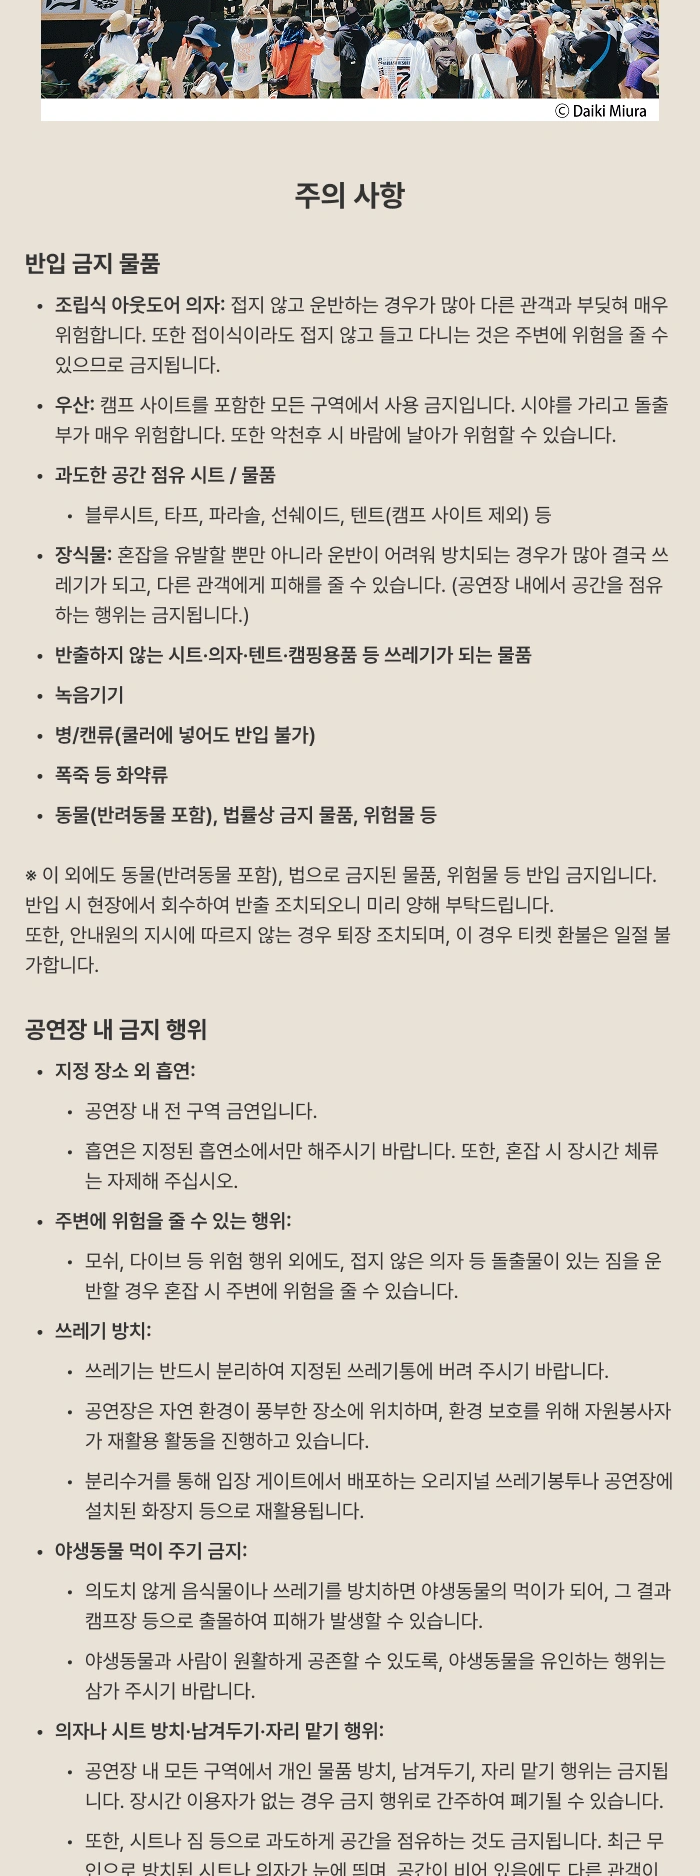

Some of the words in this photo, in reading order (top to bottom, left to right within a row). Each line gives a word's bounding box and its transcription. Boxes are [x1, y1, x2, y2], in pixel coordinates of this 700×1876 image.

[295, 182, 344, 209] 주의
[354, 182, 405, 209] 사항
[26, 253, 65, 274] 반입
[72, 253, 112, 274] 금지
[119, 253, 160, 274] 물품
[55, 396, 94, 414] 우산:
[101, 396, 134, 414] 캠프
[140, 396, 208, 414] 사이트를
[214, 396, 266, 414] 포함한
[271, 397, 305, 414] 모든
[311, 396, 378, 414] 구역에서
[385, 396, 419, 414] 사용
[424, 396, 514, 414] 금지입니다.
[521, 396, 572, 414] 시야를
[578, 396, 629, 414] 가리고
[635, 396, 668, 414] 돌출
[55, 686, 122, 704] 녹음기기
[25, 1019, 87, 1040] 공연장
[94, 1019, 112, 1040] 내
[119, 1019, 159, 1040] 금지
[166, 1019, 206, 1040] 행위
[56, 1062, 88, 1080] 지정
[95, 1062, 129, 1080] 장소
[134, 1062, 149, 1080] 외
[156, 1062, 195, 1080] 흡연:
